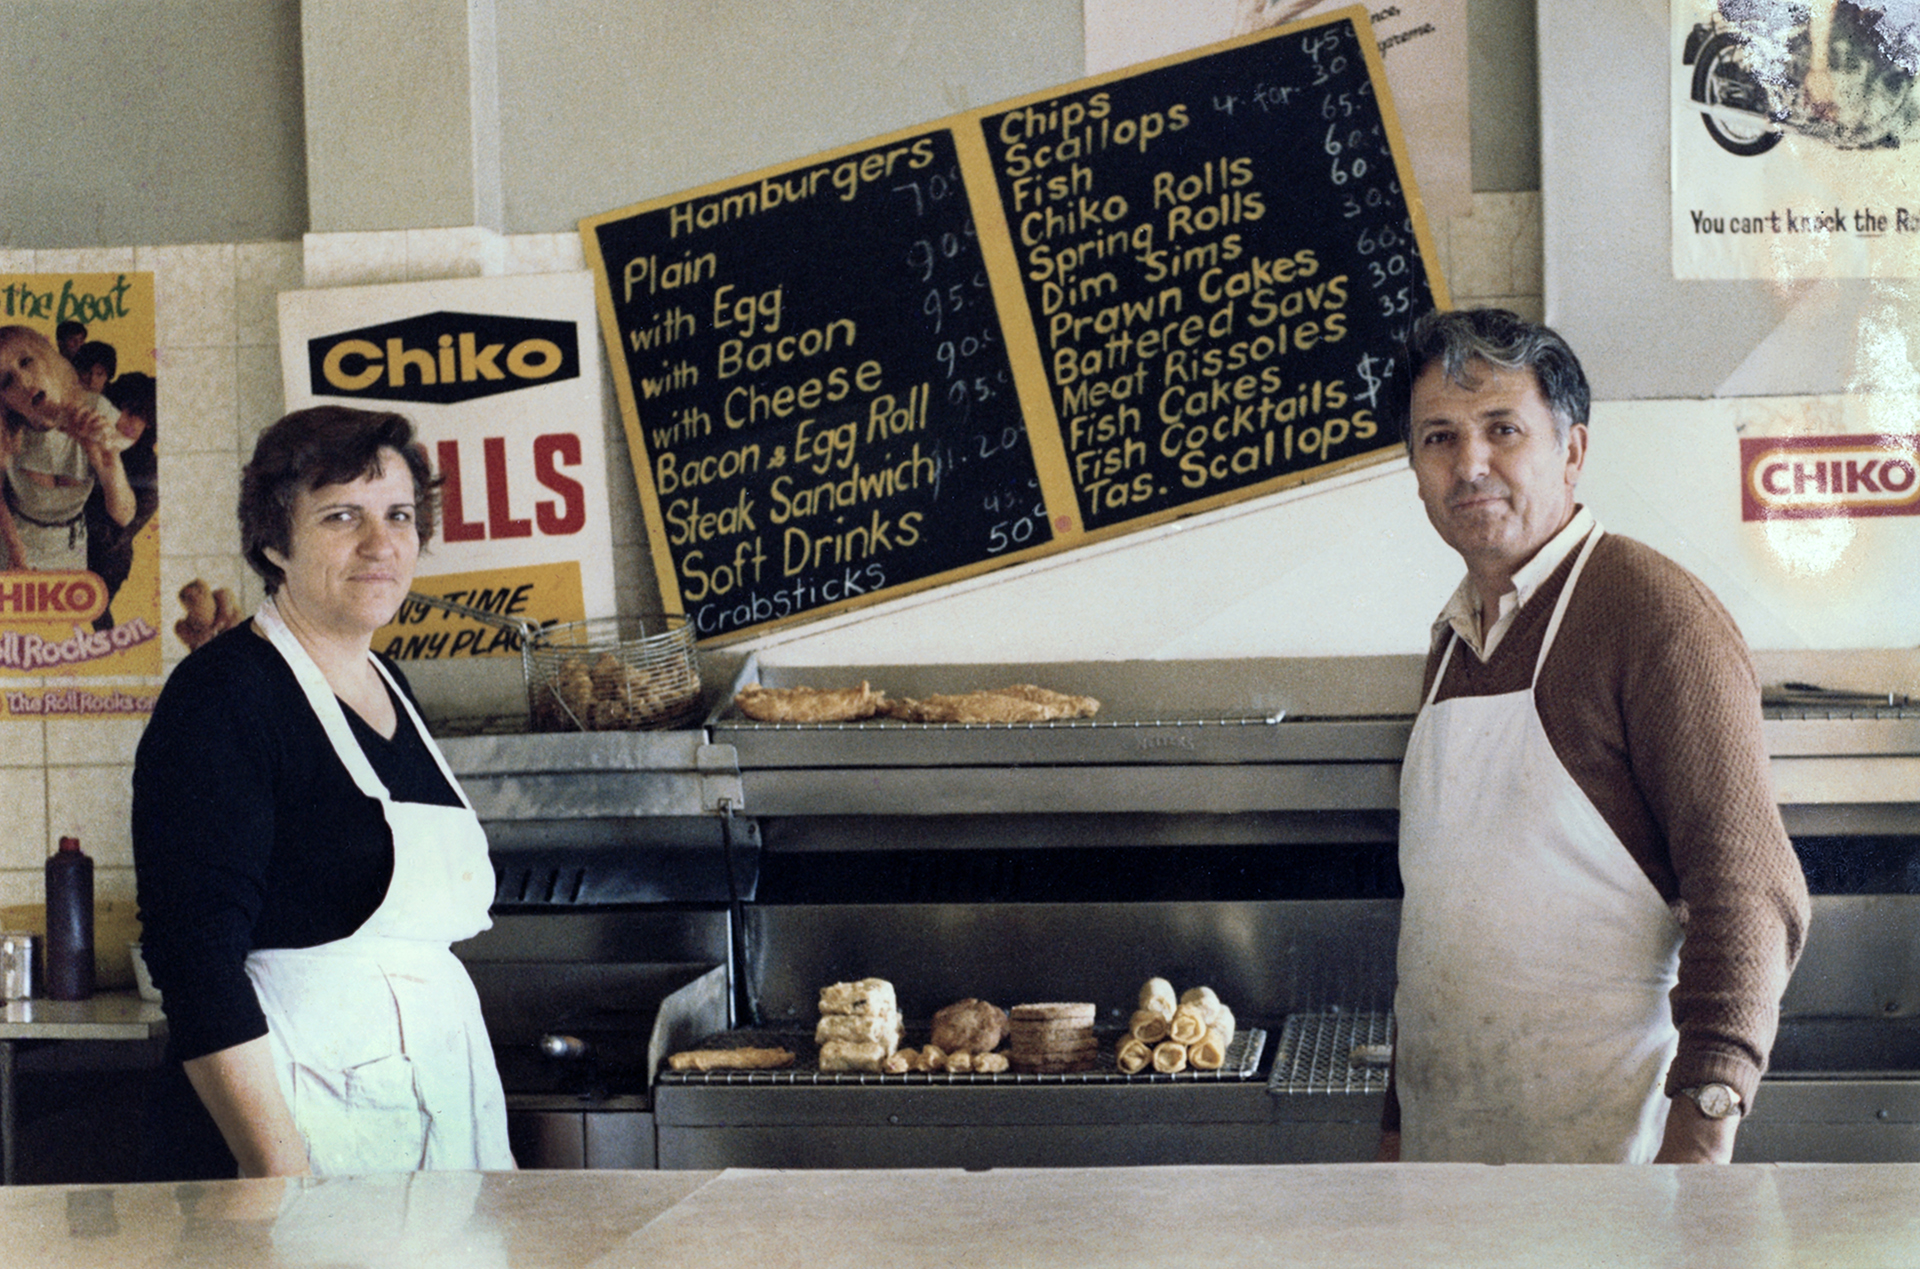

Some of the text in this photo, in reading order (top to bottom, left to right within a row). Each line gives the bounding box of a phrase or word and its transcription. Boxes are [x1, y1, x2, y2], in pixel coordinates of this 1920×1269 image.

[1000, 92, 1111, 145] Chips
[1005, 103, 1190, 177] Scallops
[670, 137, 935, 238] Hamburgers
[1012, 164, 1093, 211] Fish
[1020, 195, 1129, 247] Chiko
[1153, 157, 1253, 209] Rolls
[1690, 209, 1724, 234] You
[1730, 209, 1781, 234] can't
[1787, 207, 1847, 234] knock
[1854, 207, 1887, 233] the
[623, 250, 717, 303] Plain
[1029, 223, 1155, 286] Spring
[1168, 191, 1266, 241] Rolls
[1041, 271, 1118, 315] Dim
[1144, 233, 1243, 283] Sims
[2, 274, 131, 325] the beat
[630, 307, 696, 353] with
[713, 284, 784, 338] Egg
[1050, 286, 1183, 348] Prawn
[1200, 249, 1320, 302] Cakes
[1054, 303, 1234, 385] Battered
[1247, 275, 1348, 327] Savs
[323, 331, 563, 391] Chiko
[641, 360, 699, 400] with
[717, 317, 857, 379] Bacon
[1062, 362, 1149, 417] Meat
[1165, 313, 1347, 385] Rissoles
[652, 408, 711, 449] with
[724, 358, 883, 429] Cheese
[657, 443, 760, 495] Bacon
[767, 445, 788, 470] &
[795, 419, 858, 475] Egg
[867, 382, 929, 443] Roll
[1070, 403, 1140, 451] Fish
[1159, 366, 1281, 424] Cakes
[1076, 437, 1147, 484] Fish
[1160, 380, 1348, 457] Cocktails
[421, 432, 586, 544] LLS
[666, 487, 757, 546] Steak
[769, 443, 935, 524] Sandwich
[1085, 410, 1378, 515] Tas. Scallops
[1762, 459, 1916, 495] CHIKO
[0, 581, 97, 612] HIKO
[681, 536, 767, 601] Soft
[784, 510, 924, 577] Drinks
[443, 583, 534, 622] TIME
[697, 563, 887, 633] Crabsticks
[23, 625, 112, 669] Rocks
[112, 616, 156, 650] on
[384, 630, 448, 660] ANY
